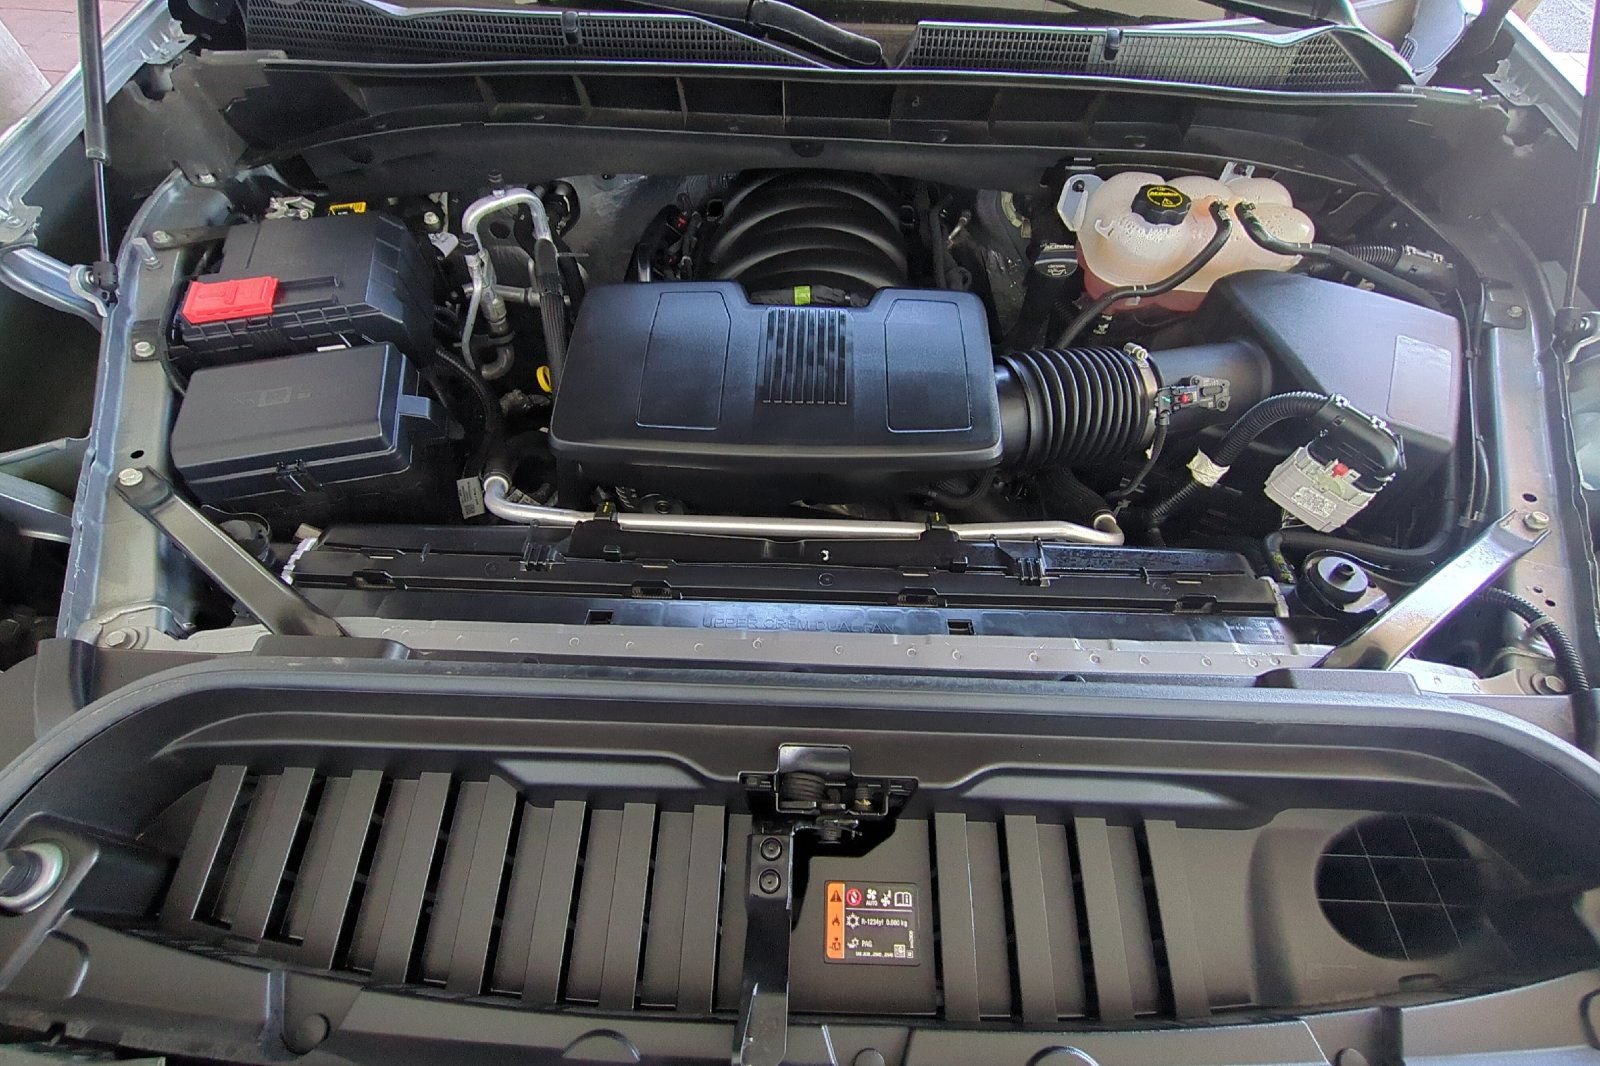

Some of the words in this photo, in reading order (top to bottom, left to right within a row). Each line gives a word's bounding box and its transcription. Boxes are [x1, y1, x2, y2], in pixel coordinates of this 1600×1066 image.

[702, 616, 757, 629] UPPER
[815, 620, 859, 632] DUAL
[863, 622, 895, 633] FAN
